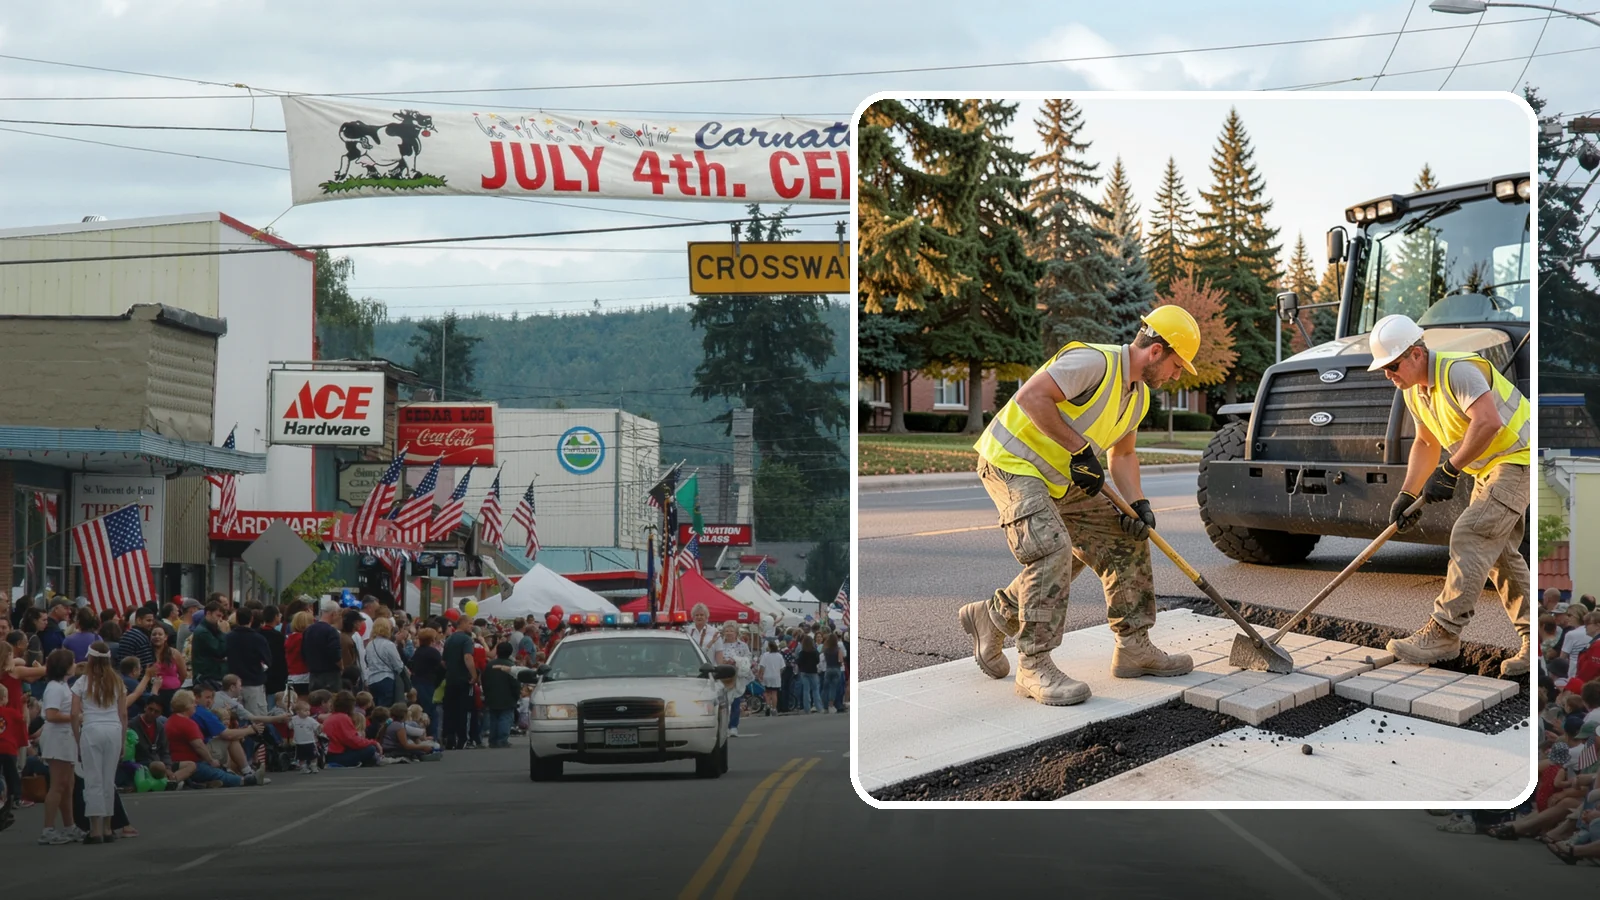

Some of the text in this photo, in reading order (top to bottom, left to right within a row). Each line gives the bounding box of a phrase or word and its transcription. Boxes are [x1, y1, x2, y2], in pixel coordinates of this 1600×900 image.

[695, 121, 850, 150] Carnat
[481, 141, 604, 192] JULY
[632, 149, 746, 198] 4th.
[696, 254, 850, 280] CROSSWA
[283, 380, 374, 420] ACE
[405, 409, 453, 422] CEDAR
[283, 421, 371, 437] Hardware
[416, 427, 478, 447] Coca-Cola
[353, 467, 384, 480] Simpl
[83, 485, 155, 495] St. Vincent de Paul
[688, 526, 741, 535] CRNATION
[699, 535, 730, 543] GLASS
